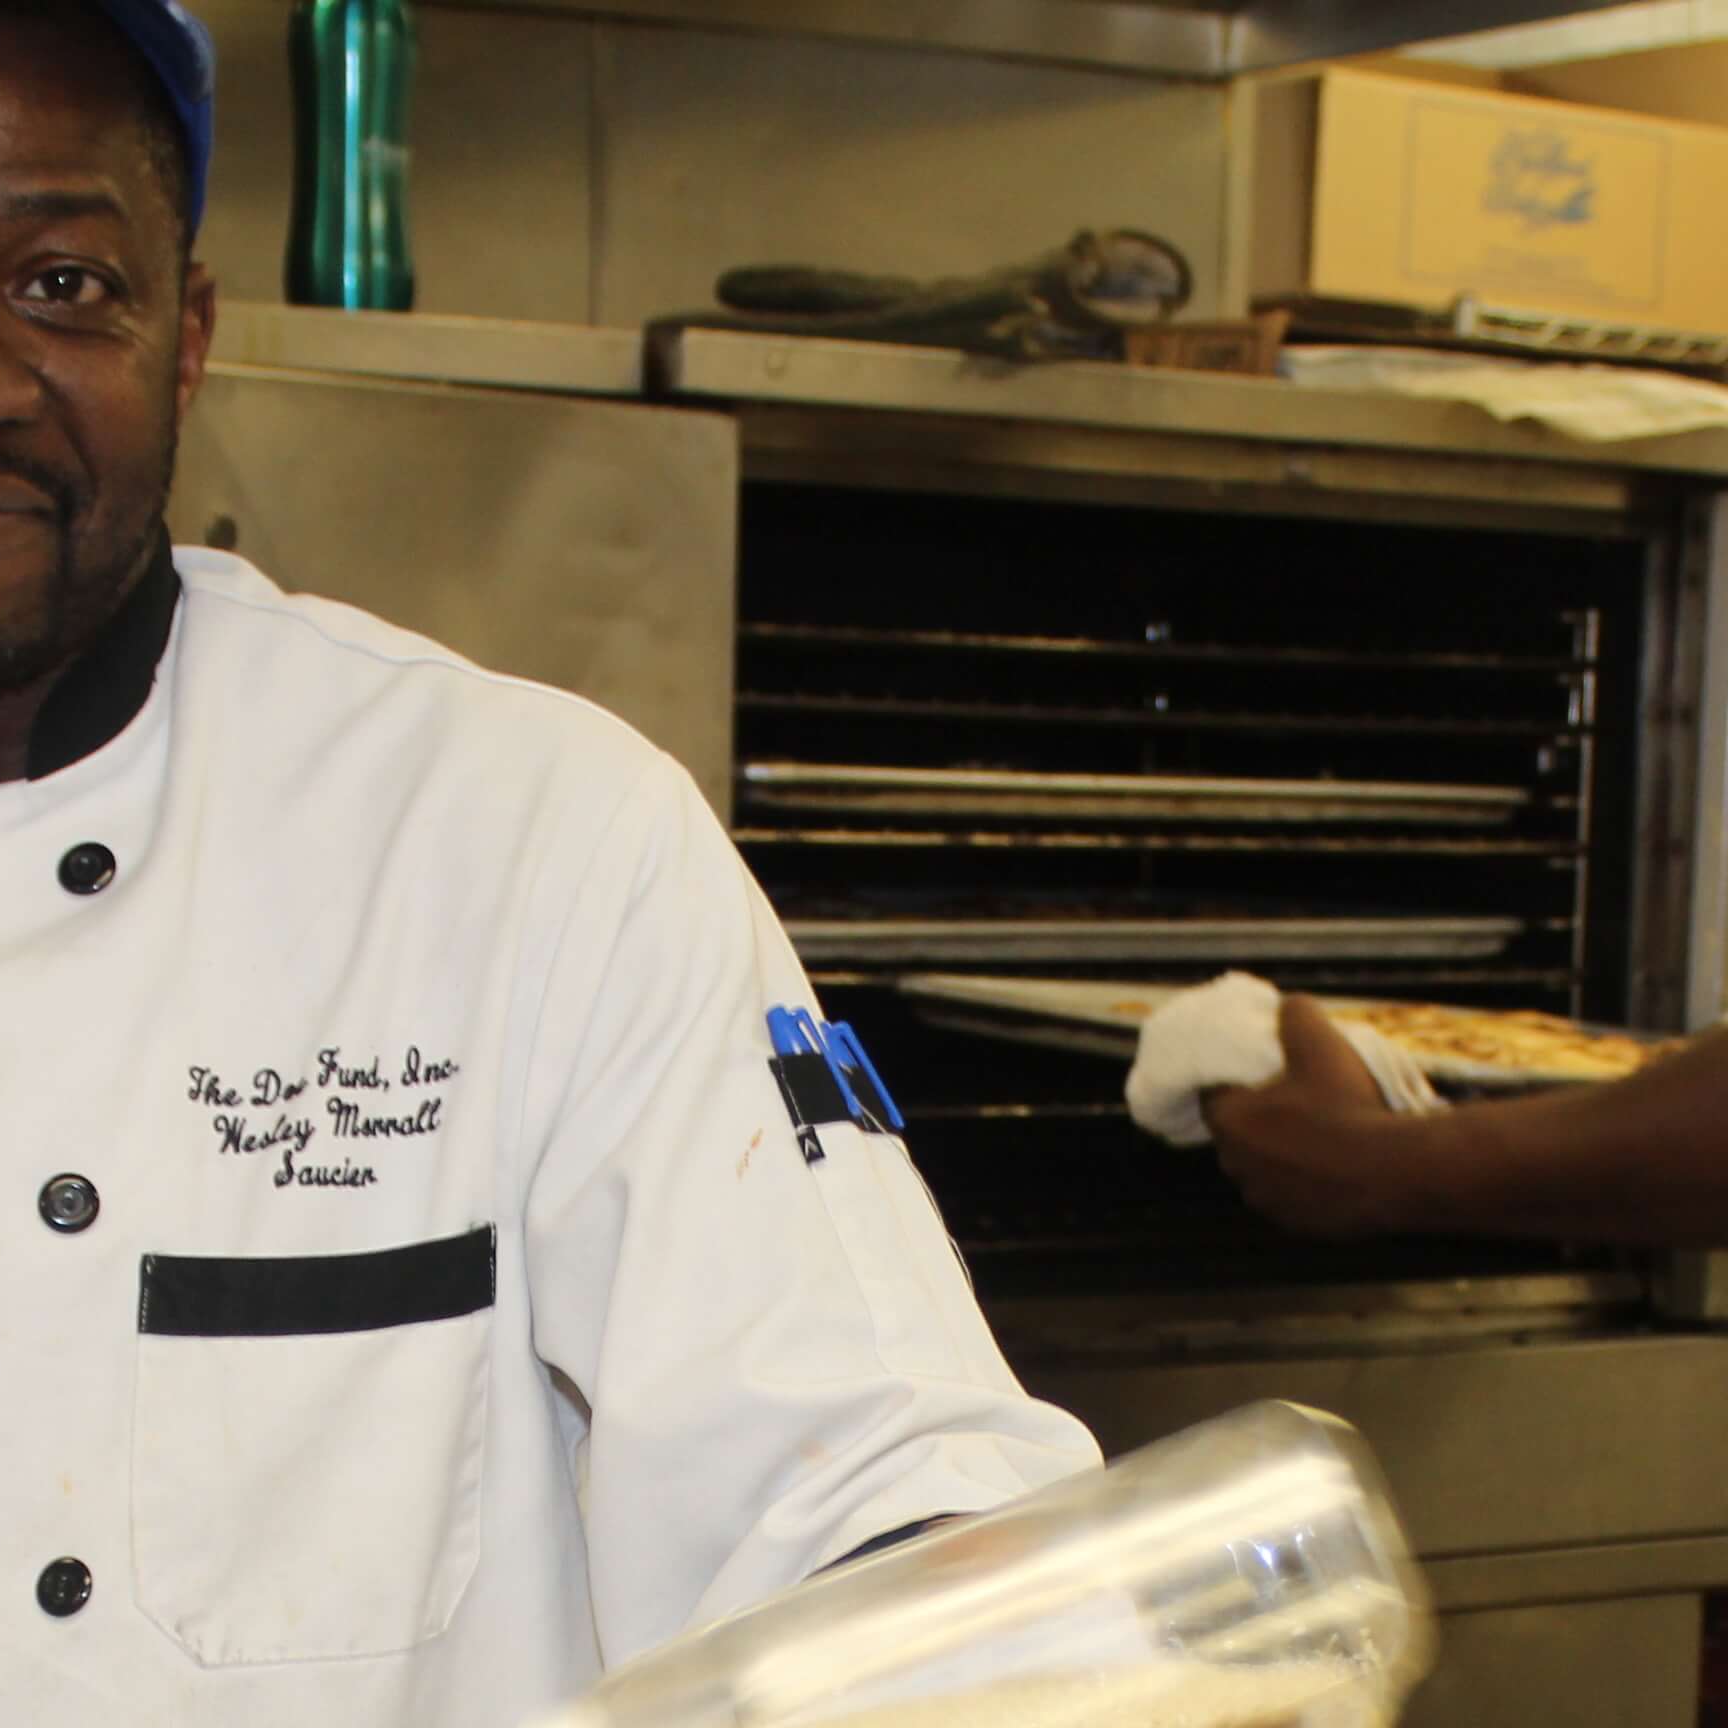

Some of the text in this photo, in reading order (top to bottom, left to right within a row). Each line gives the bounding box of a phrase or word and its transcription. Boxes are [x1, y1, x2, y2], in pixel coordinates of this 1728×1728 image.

[187, 1066, 244, 1109] The
[316, 1046, 391, 1092] Fund,
[213, 1114, 316, 1154] Wesley
[273, 1149, 379, 1189] Saucier
